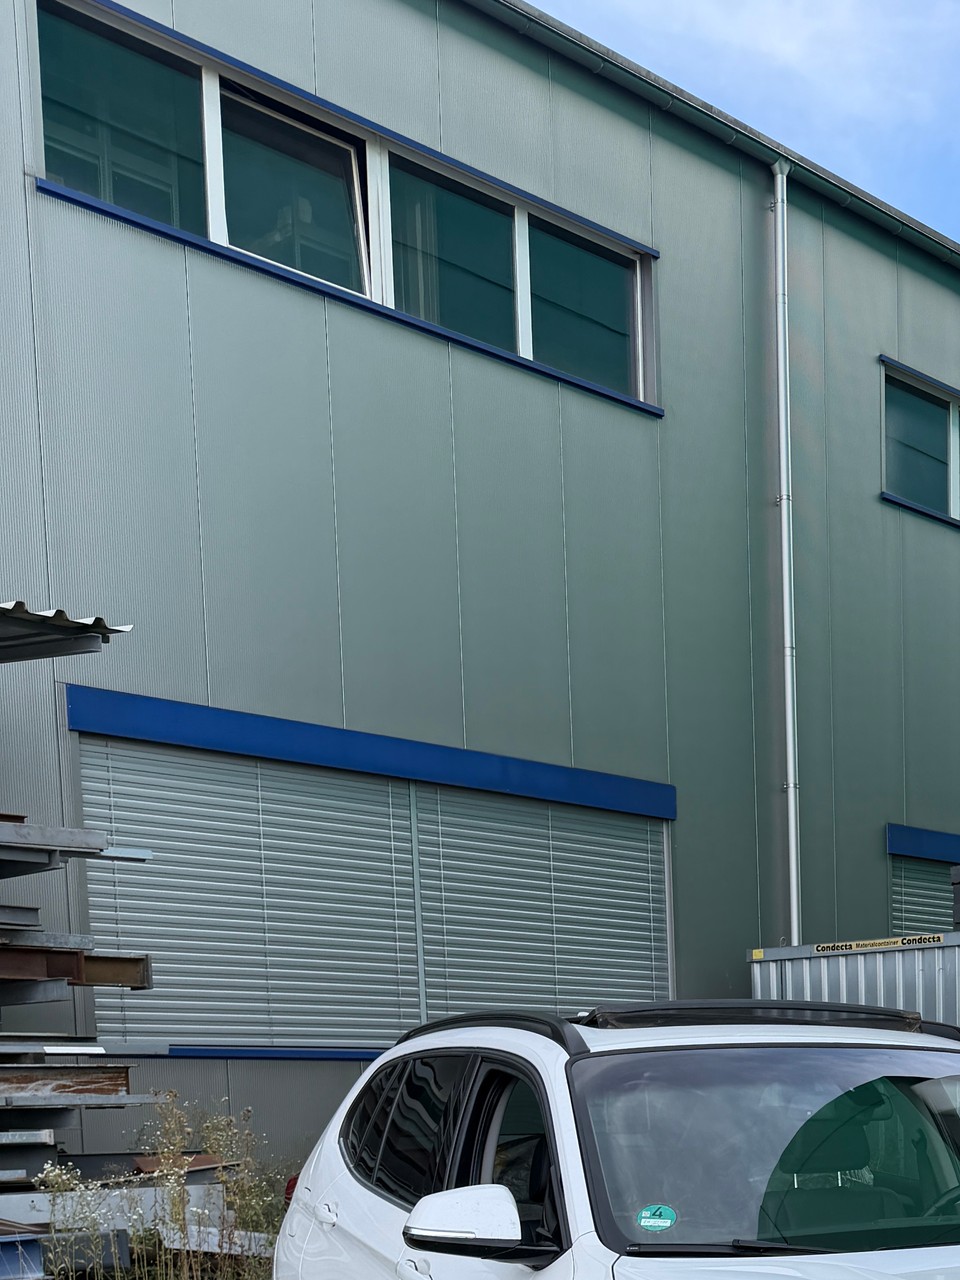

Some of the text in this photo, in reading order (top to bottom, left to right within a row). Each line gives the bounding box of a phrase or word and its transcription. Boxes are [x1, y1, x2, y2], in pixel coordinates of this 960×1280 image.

[816, 935, 941, 952] Condecta Materialcontainer Condecta
[652, 1206, 664, 1218] 4
